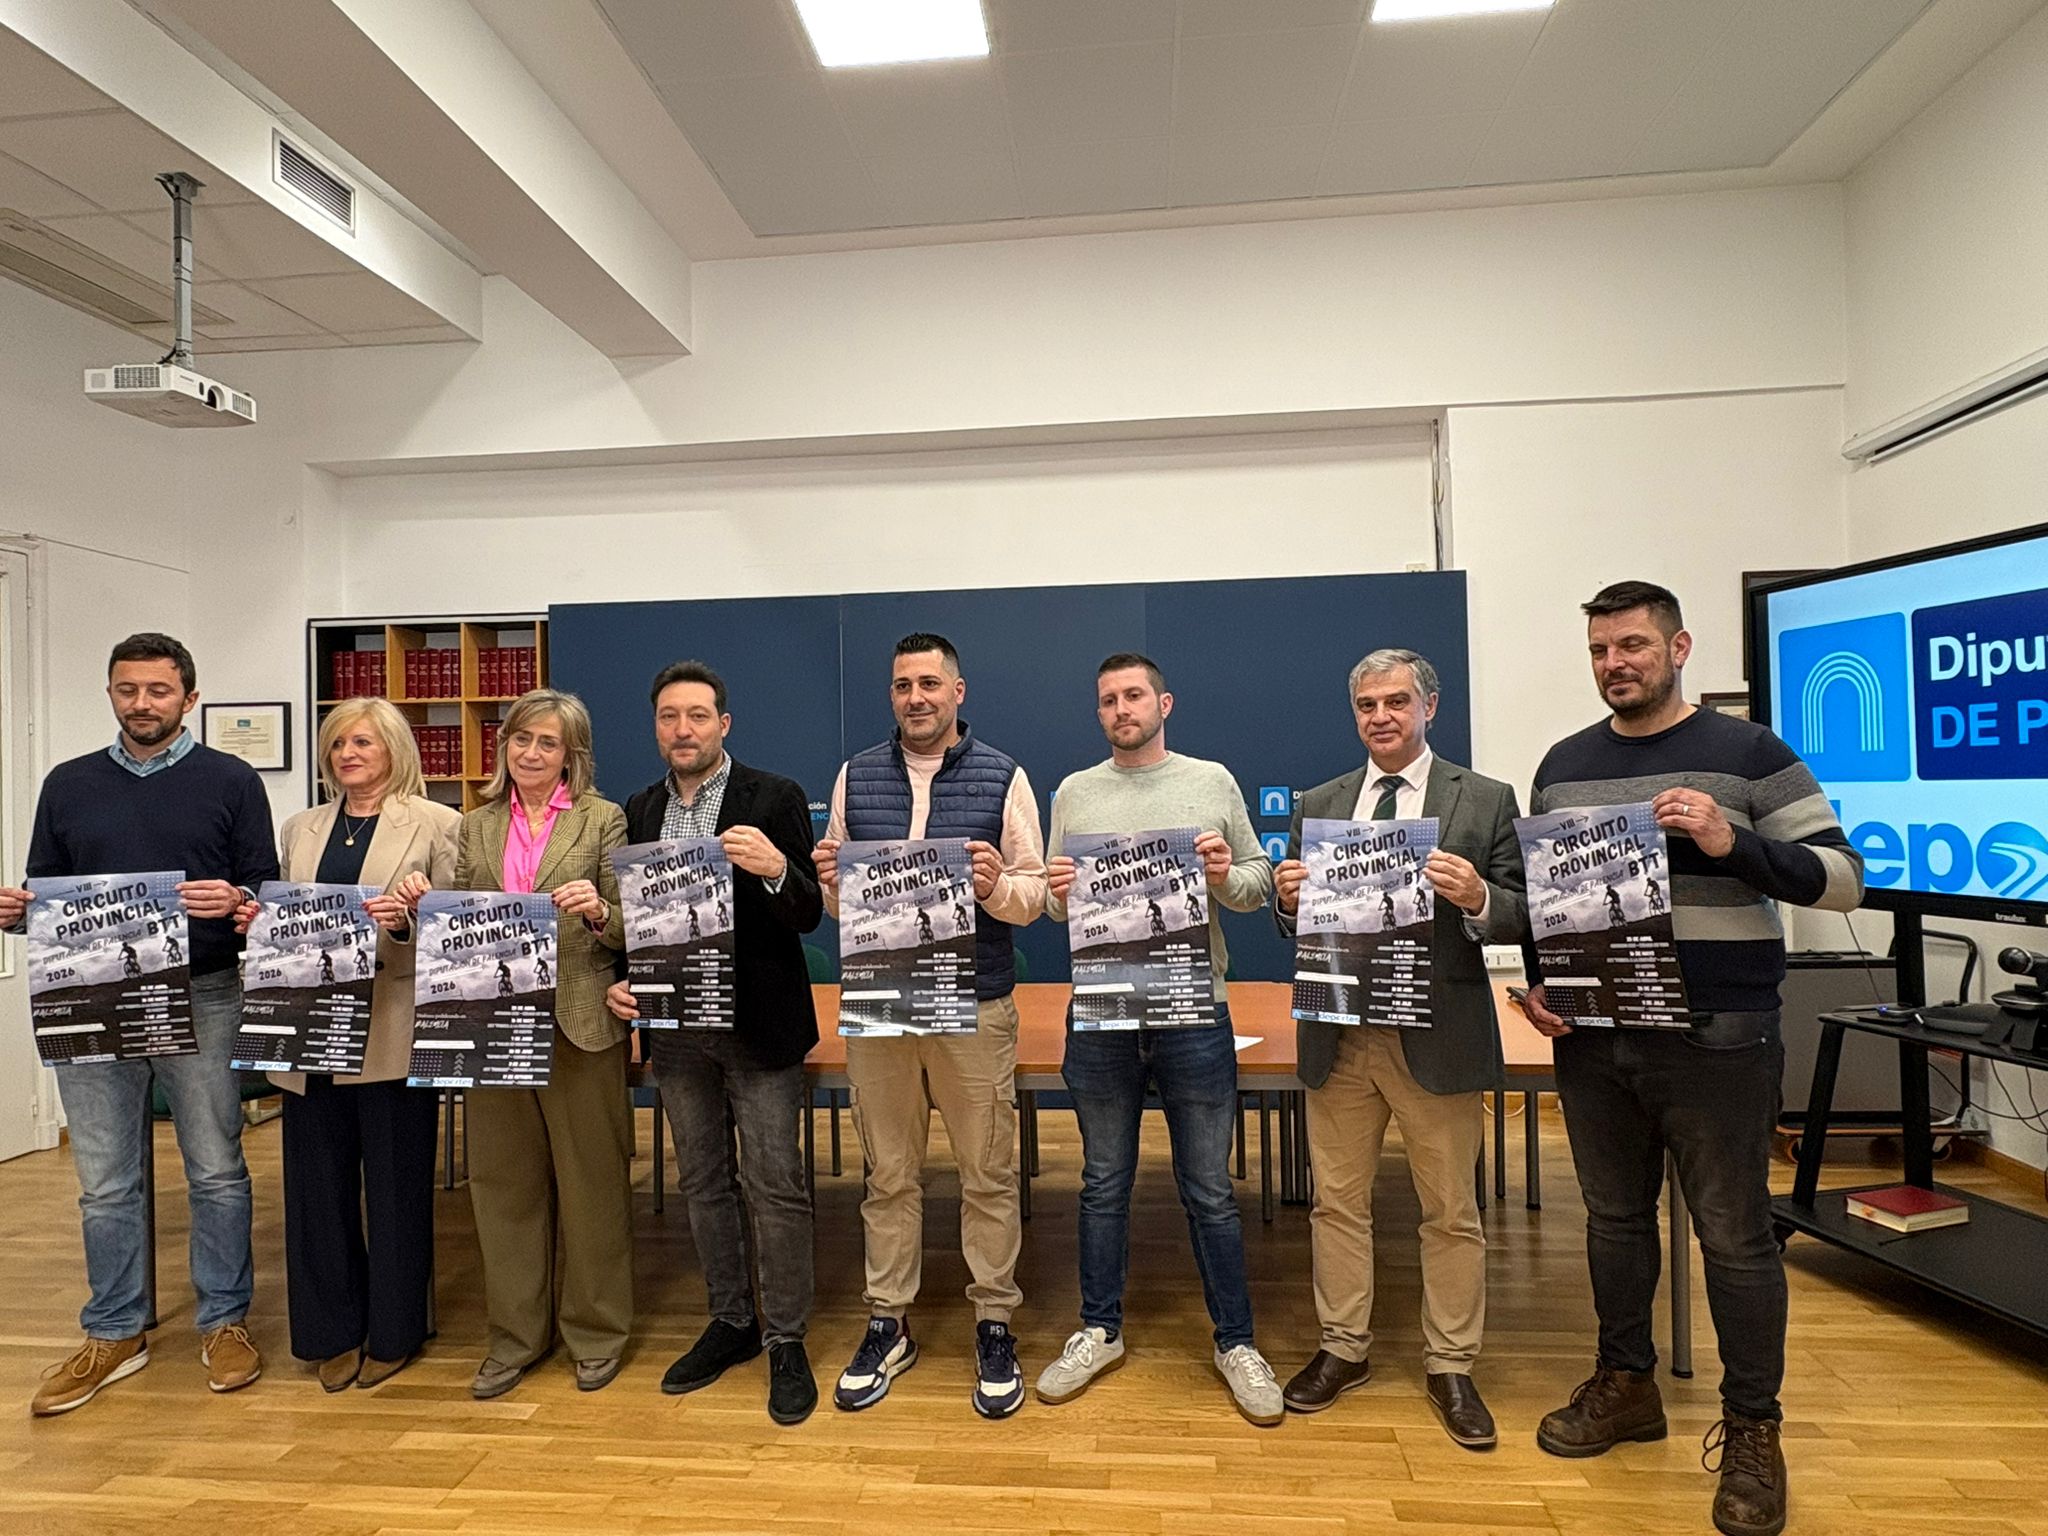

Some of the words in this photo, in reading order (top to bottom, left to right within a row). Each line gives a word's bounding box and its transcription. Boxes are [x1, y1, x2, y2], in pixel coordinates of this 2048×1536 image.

[1929, 632, 2048, 687] Dipu
[1932, 702, 2000, 748] DE
[1346, 827, 1360, 838] VIII
[1560, 820, 1575, 831] VIII
[1104, 839, 1119, 850] VIII
[1333, 829, 1406, 861] CIRCUITO
[1553, 816, 1628, 857] CIRCUITO
[650, 847, 663, 857] VIII
[876, 847, 890, 858] VIII
[1095, 838, 1168, 873] CIRCUITO
[1549, 834, 1646, 882] PROVINCIAL
[644, 847, 704, 879] CIRCUITO
[867, 848, 938, 881] CIRCUITO
[1326, 847, 1421, 884] PROVINCIAL
[1628, 852, 1660, 878] BTT
[641, 863, 719, 901] PROVINCIAL
[862, 865, 955, 903] PROVINCIAL
[1090, 855, 1186, 896] PROVINCIAL
[1170, 872, 1198, 893] BTT
[1404, 869, 1421, 886] BT
[76, 882, 92, 893] VIII
[288, 888, 301, 898] VIII
[706, 880, 728, 899] BTT
[939, 882, 967, 902] BTT
[63, 882, 147, 917] CIRCUITO
[277, 893, 346, 920] CIRCUITO
[460, 897, 474, 908] VIII
[56, 899, 166, 940] PROVINCIAL
[148, 915, 179, 936] BTT
[270, 911, 360, 941] PROVINCIAL
[449, 902, 524, 931] CIRCUITO
[1313, 914, 1339, 925] 2026
[1544, 912, 1567, 928] 2026
[343, 929, 370, 946] BTT
[442, 919, 539, 953] PROVINCIAL
[637, 929, 657, 941] 2026
[854, 932, 878, 945] 2026
[1084, 925, 1109, 939] 2026
[522, 938, 550, 956] BTT
[46, 968, 75, 982] 2026
[259, 968, 282, 980] 2026
[431, 980, 455, 994] 2026
